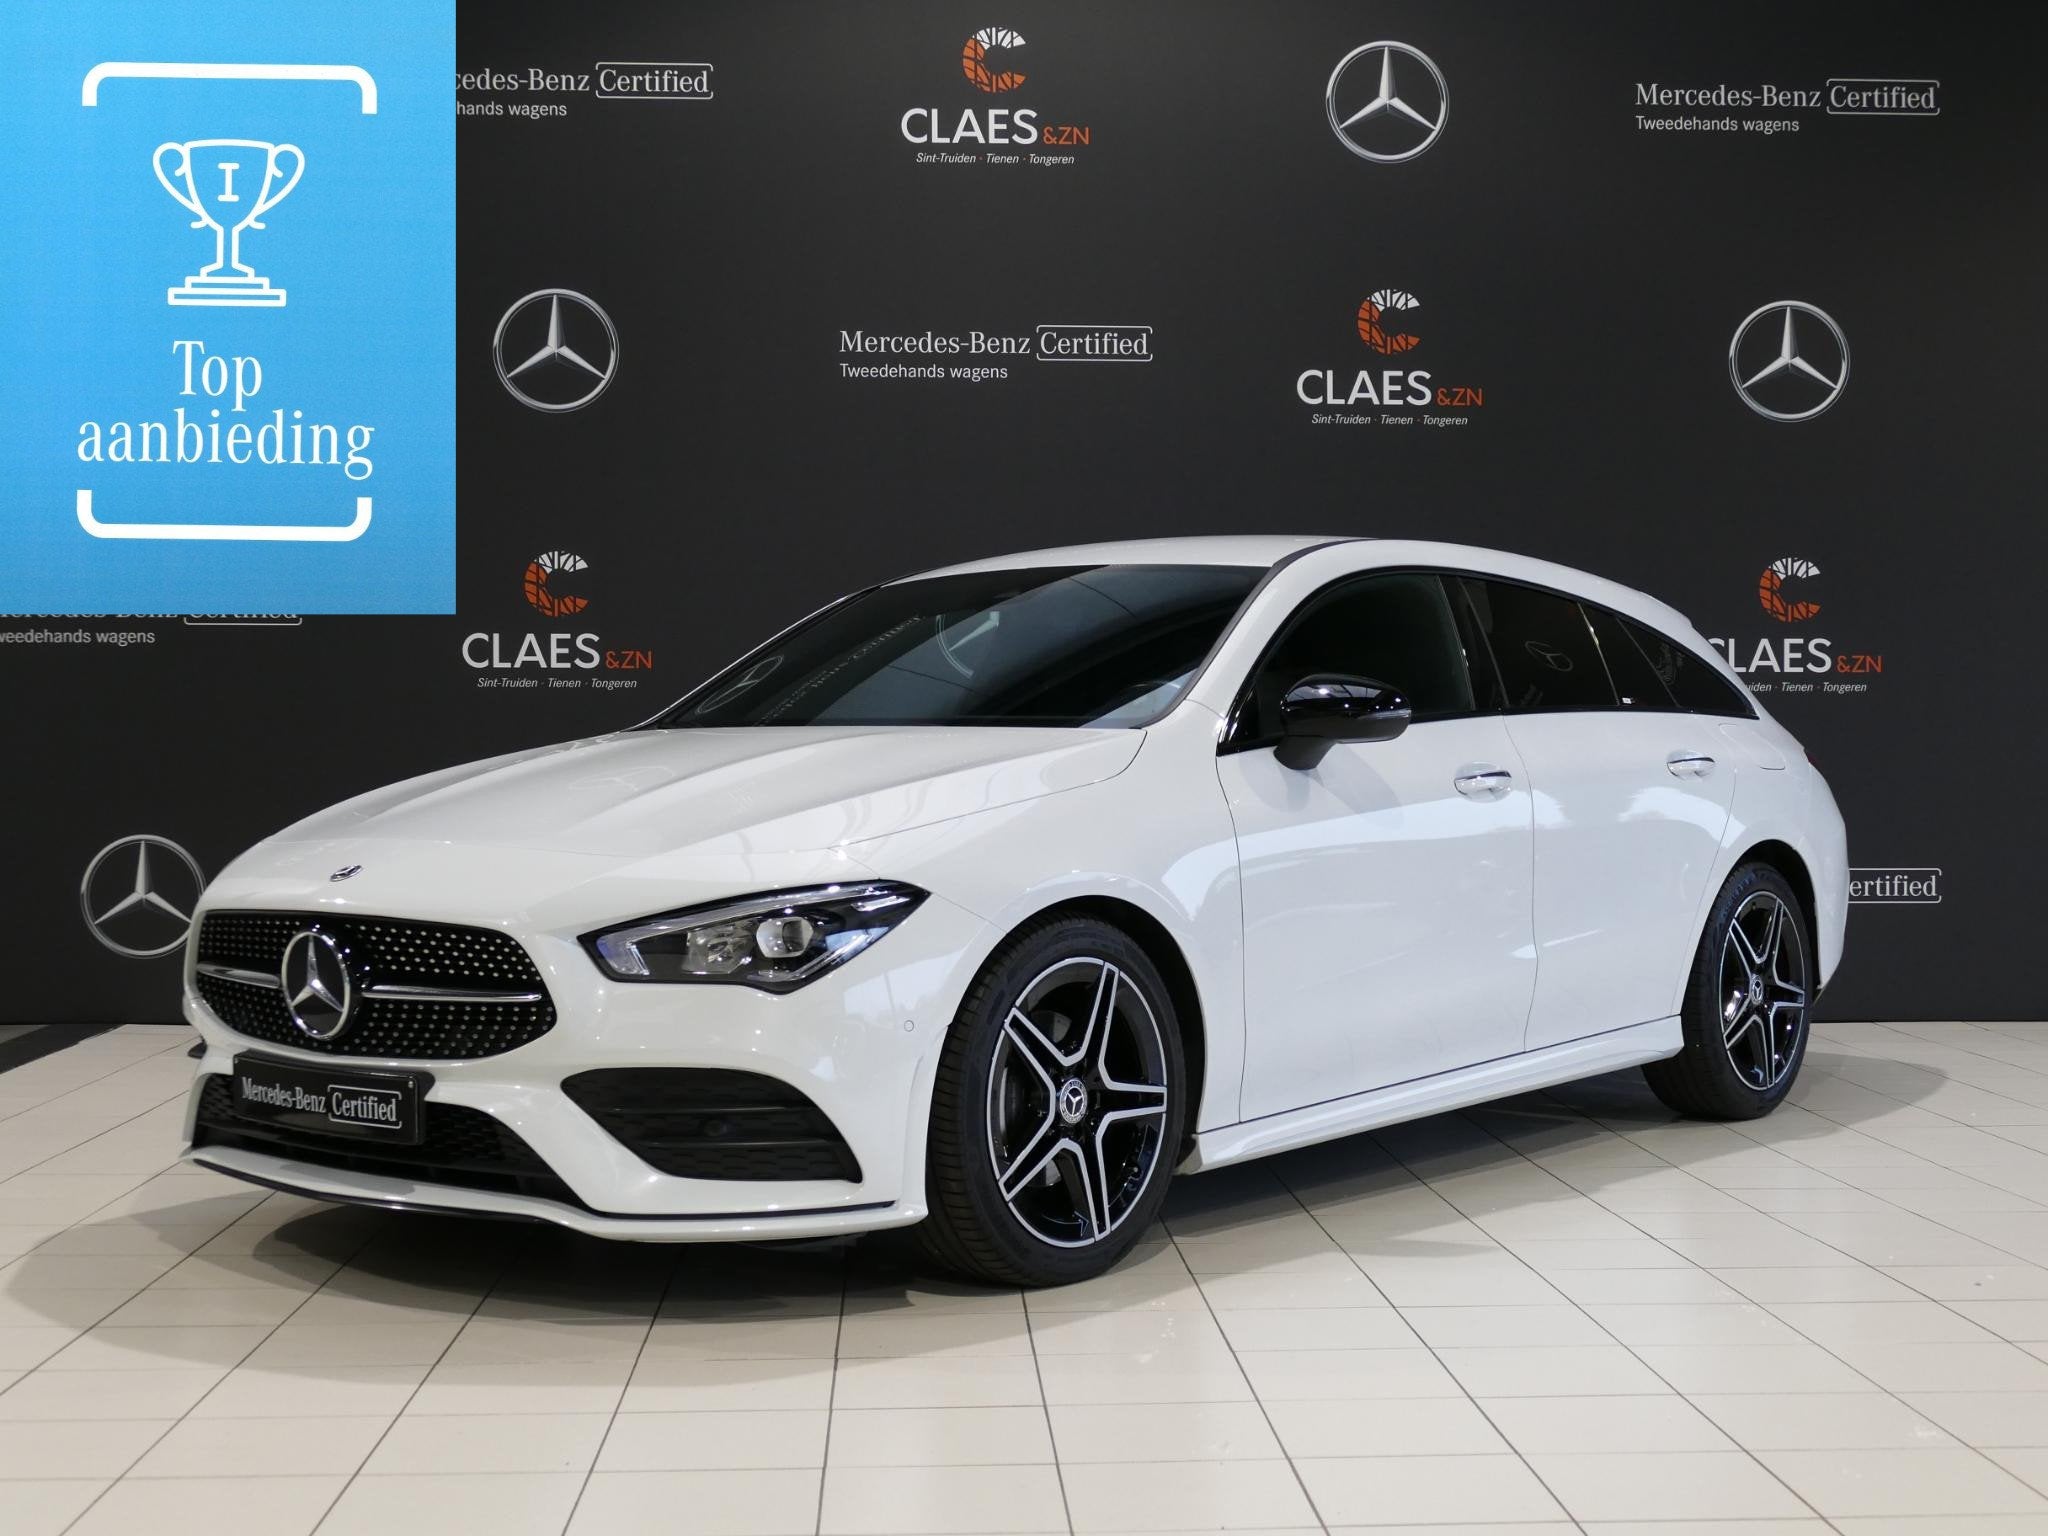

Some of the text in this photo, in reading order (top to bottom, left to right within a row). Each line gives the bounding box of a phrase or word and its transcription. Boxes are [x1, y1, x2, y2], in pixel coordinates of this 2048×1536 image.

[600, 69, 709, 92] Certified
[1636, 84, 1935, 108] Mercedes-Benz Certified
[509, 105, 566, 119] wagens
[901, 108, 1089, 144] CLAES &ZN
[1636, 116, 1799, 134] Tweedehands wagens
[917, 153, 1074, 166] Sint-Truiden Tienen Tongeren
[840, 331, 1149, 355] Mercedes-Benz Certified
[840, 364, 1007, 382] Tweedehands wagens
[1297, 370, 1482, 406] CLAES &ZN
[1312, 414, 1467, 427] Sint-Truiden Tienen Tongeren
[96, 633, 155, 646] wagens
[462, 633, 652, 668] CLAES &ZN
[1837, 656, 1881, 672] &ZN
[478, 678, 637, 690] Sint-Truiden Tienen Tongeren
[1782, 682, 1813, 691] Tienen
[1824, 682, 1866, 694] Tongeren
[1850, 875, 1936, 896] ertified
[242, 1077, 397, 1121] Mercedes-Benz Certified
